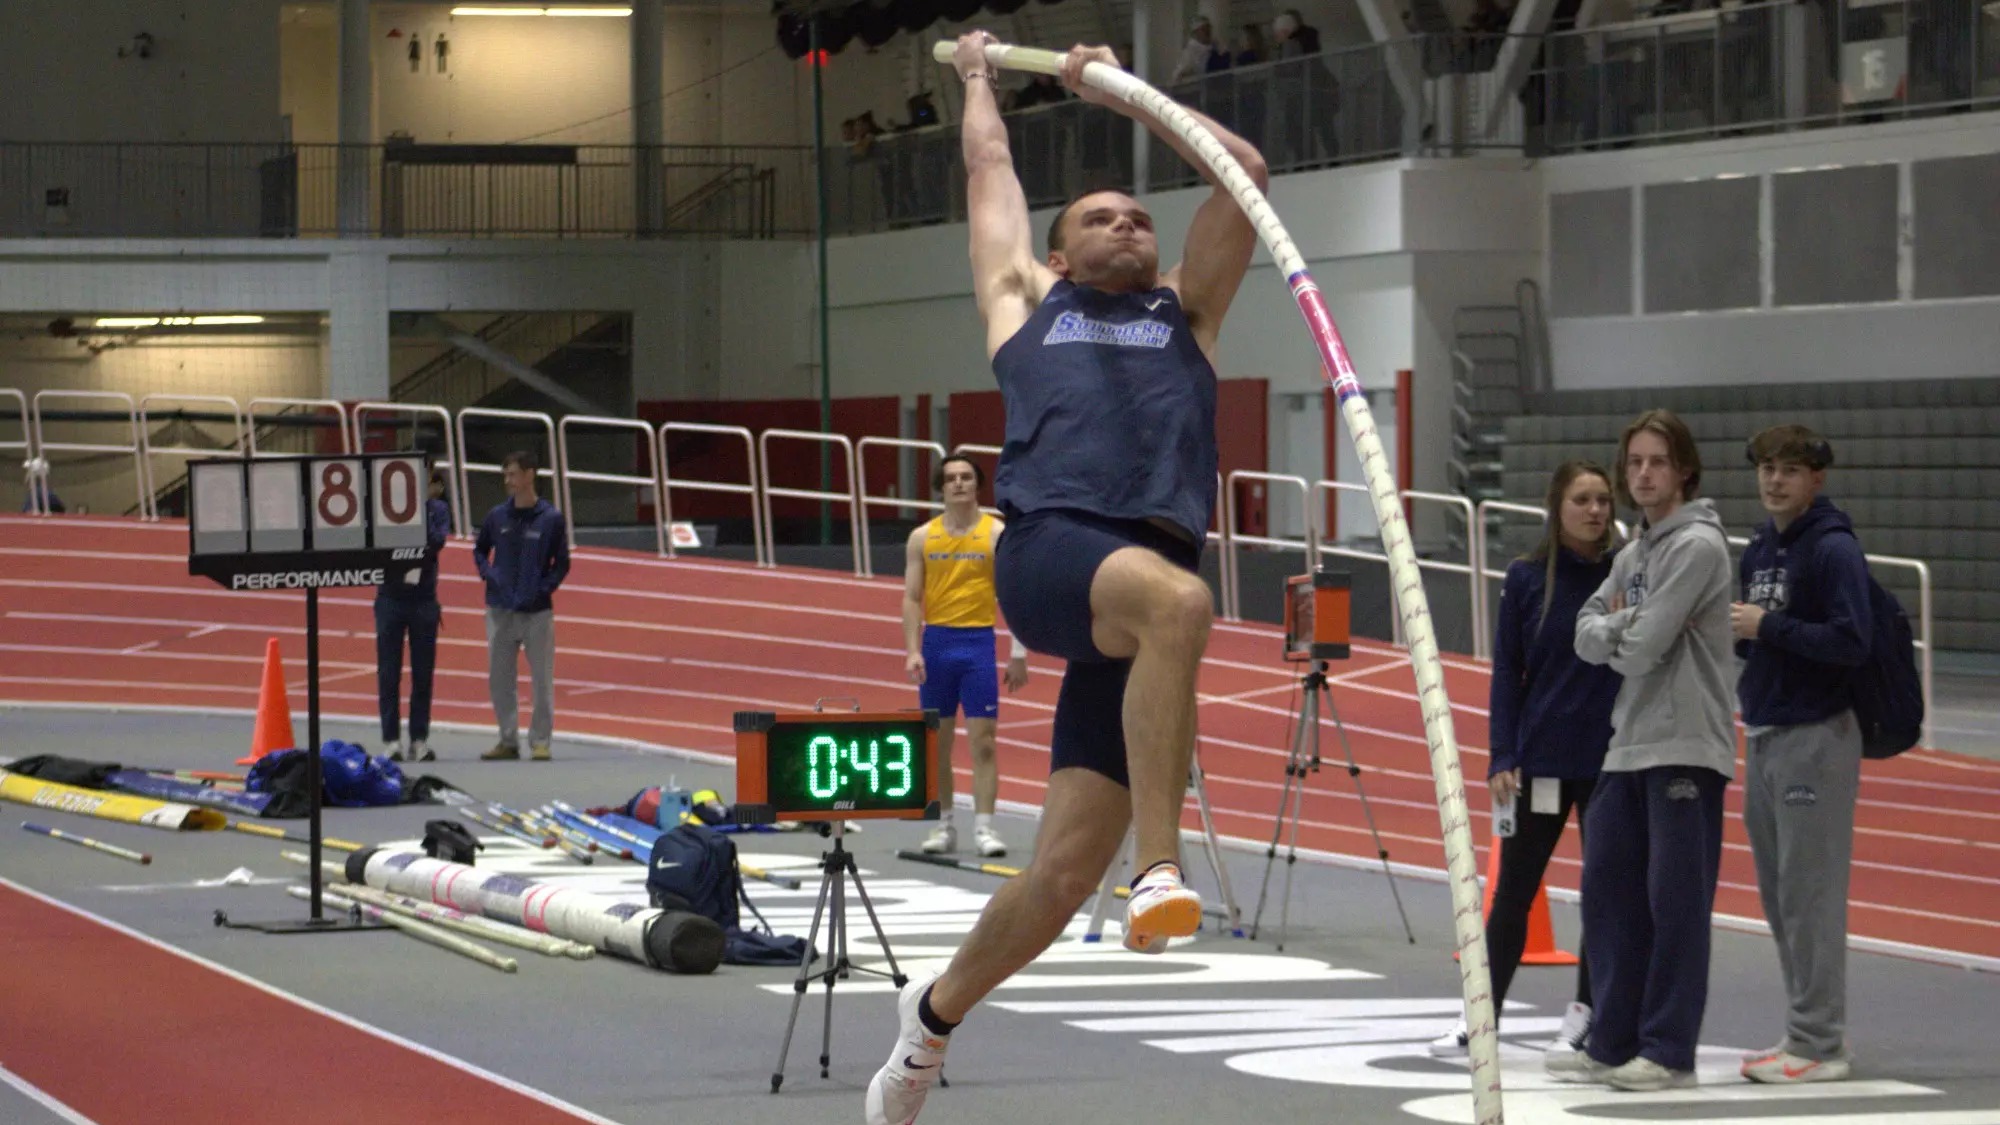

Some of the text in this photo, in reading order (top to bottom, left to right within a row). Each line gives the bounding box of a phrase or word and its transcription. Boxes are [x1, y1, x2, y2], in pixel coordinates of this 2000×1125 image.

[391, 547, 426, 560] GILL
[232, 568, 385, 590] PERFORMANCE
[808, 735, 911, 798] 0:43
[833, 801, 856, 810] GILL
